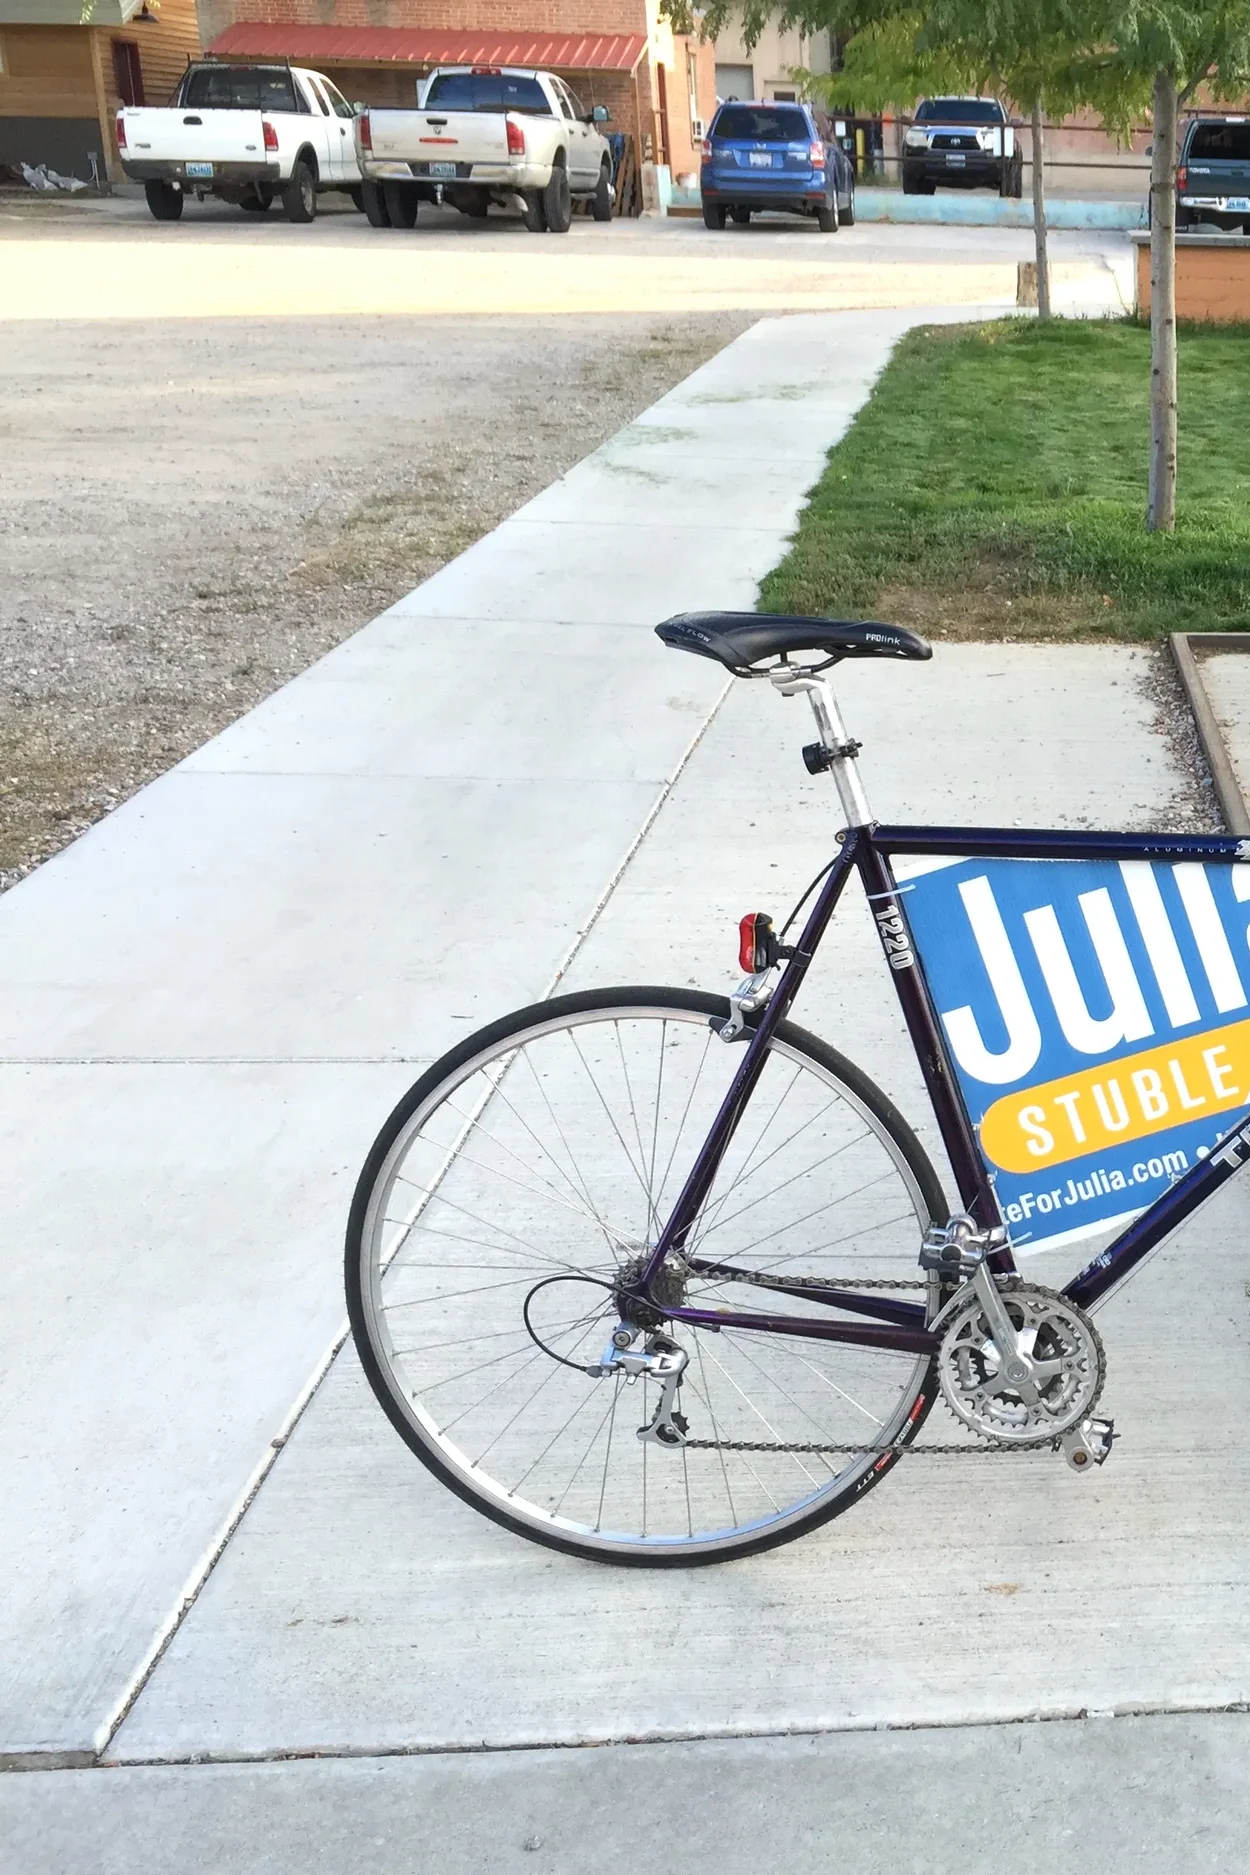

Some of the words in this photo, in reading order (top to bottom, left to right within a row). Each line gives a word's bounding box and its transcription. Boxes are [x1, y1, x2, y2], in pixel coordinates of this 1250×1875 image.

[1143, 846, 1227, 854] ALUMINUM
[875, 904, 915, 970] 1220
[1017, 1044, 1240, 1157] STUBLE
